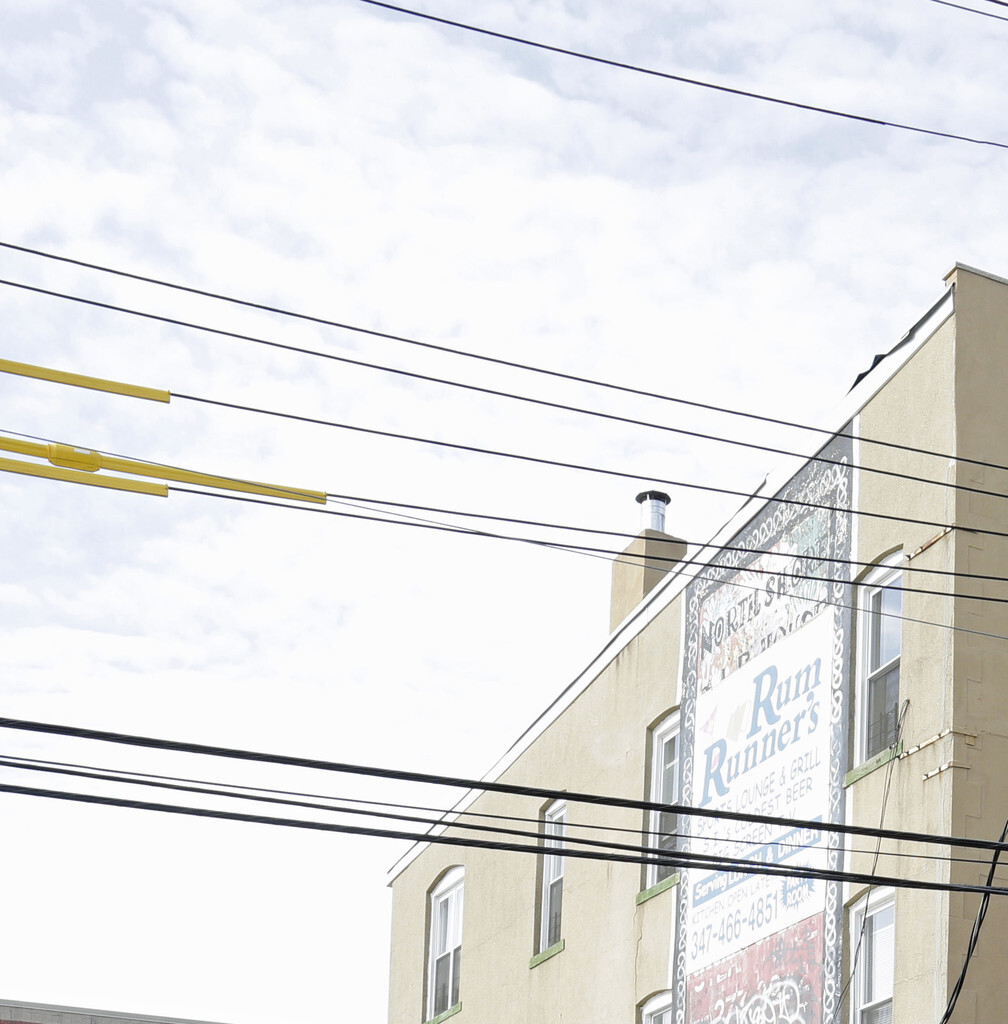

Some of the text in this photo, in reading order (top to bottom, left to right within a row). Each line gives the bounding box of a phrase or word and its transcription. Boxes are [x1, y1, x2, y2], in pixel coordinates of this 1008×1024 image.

[746, 657, 822, 740] Rum
[698, 691, 820, 808] Runner's
[735, 771, 775, 814] LOUNGE
[779, 766, 787, 786] &
[790, 746, 821, 780] GRILL
[786, 777, 813, 804] BEER
[695, 872, 727, 900] Serving
[778, 827, 818, 859] DINNER
[691, 890, 778, 960] 347-466-4851
